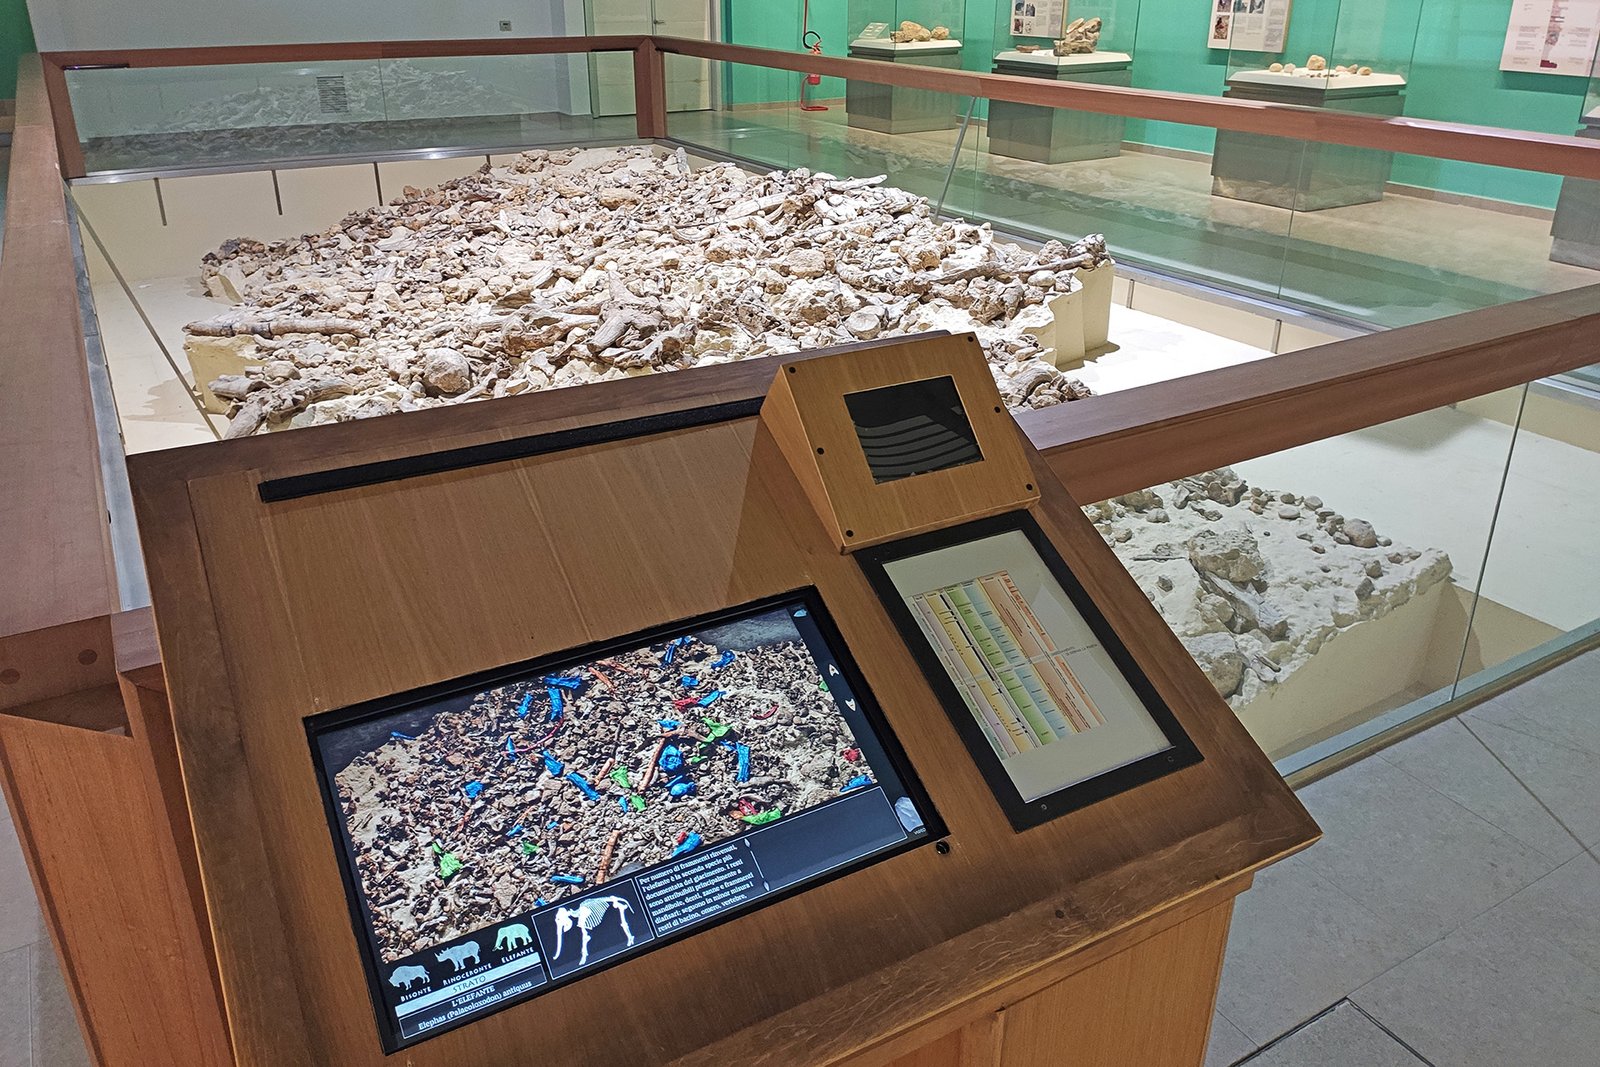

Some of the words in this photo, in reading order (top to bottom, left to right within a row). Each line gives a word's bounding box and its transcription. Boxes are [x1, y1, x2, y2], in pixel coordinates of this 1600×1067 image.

[645, 882, 684, 900] documentata
[730, 858, 744, 868] resti
[650, 869, 674, 881] numero
[680, 854, 710, 870] frammenti
[681, 865, 705, 878] seconda
[704, 858, 723, 869] specie
[648, 898, 664, 908] sono
[663, 885, 696, 902] attribuibili
[694, 870, 738, 892] principalmente
[702, 886, 721, 897] zanne
[724, 872, 755, 888] frammenti
[681, 900, 706, 913] seguono
[712, 891, 731, 902] minor
[730, 883, 751, 895] misura
[658, 922, 673, 932] resti
[501, 946, 534, 964] ELEFANTE
[442, 963, 492, 986] RINOCERONTE
[452, 975, 486, 993] STRATO
[400, 986, 432, 1002] BISONTE
[418, 1014, 447, 1030] Elephas
[502, 980, 533, 998] antiquus
[451, 985, 495, 1007] L'ELEFANTE
